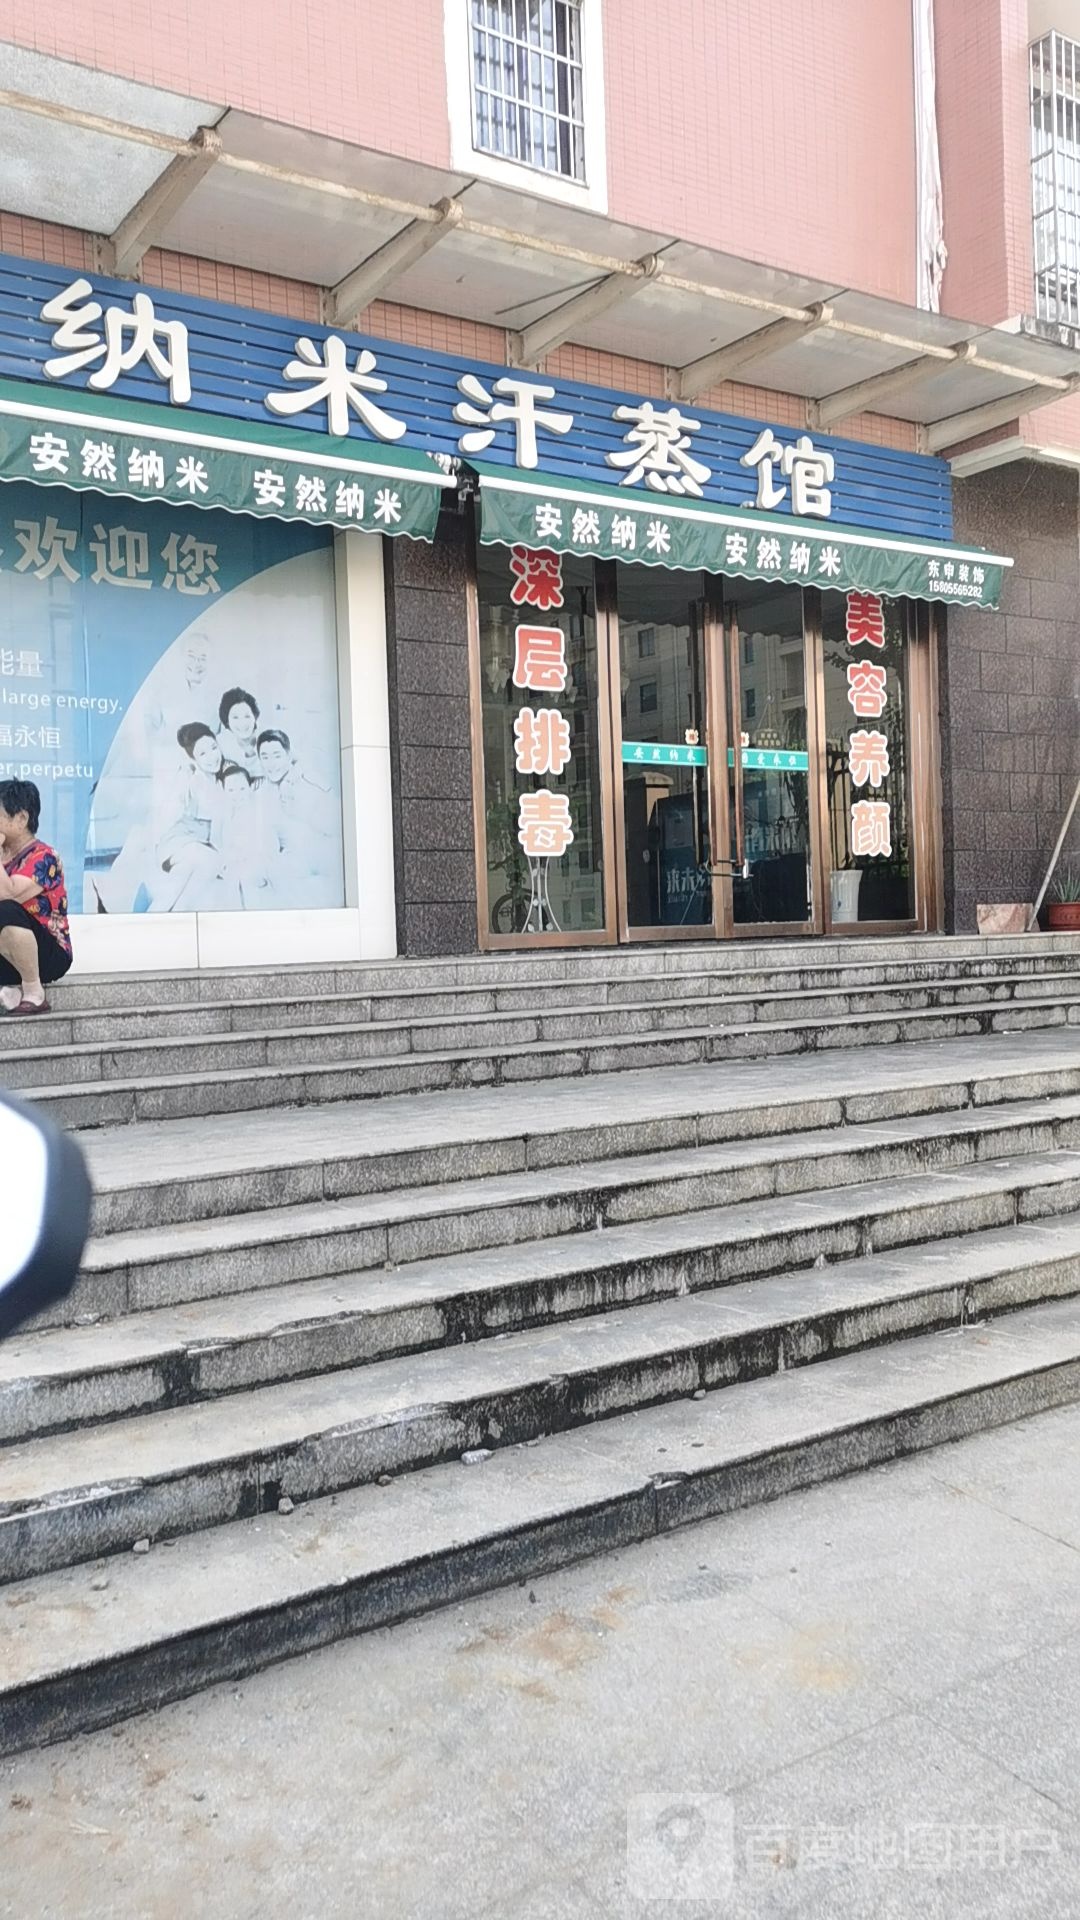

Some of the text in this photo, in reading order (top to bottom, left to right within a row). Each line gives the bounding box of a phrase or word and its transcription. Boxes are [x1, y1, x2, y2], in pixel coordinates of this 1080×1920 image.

[40, 278, 835, 517] 纳米汗蒸馆
[29, 432, 209, 494] 安然纳米
[253, 469, 402, 523] 安然纳米
[0, 516, 221, 596] 欢迎您
[534, 503, 672, 554] 安然纳米
[725, 531, 842, 577] 安然纳米
[2, 688, 123, 715] large energy.
[510, 544, 574, 857] 深层排毒
[845, 591, 892, 858] 美容养颜
